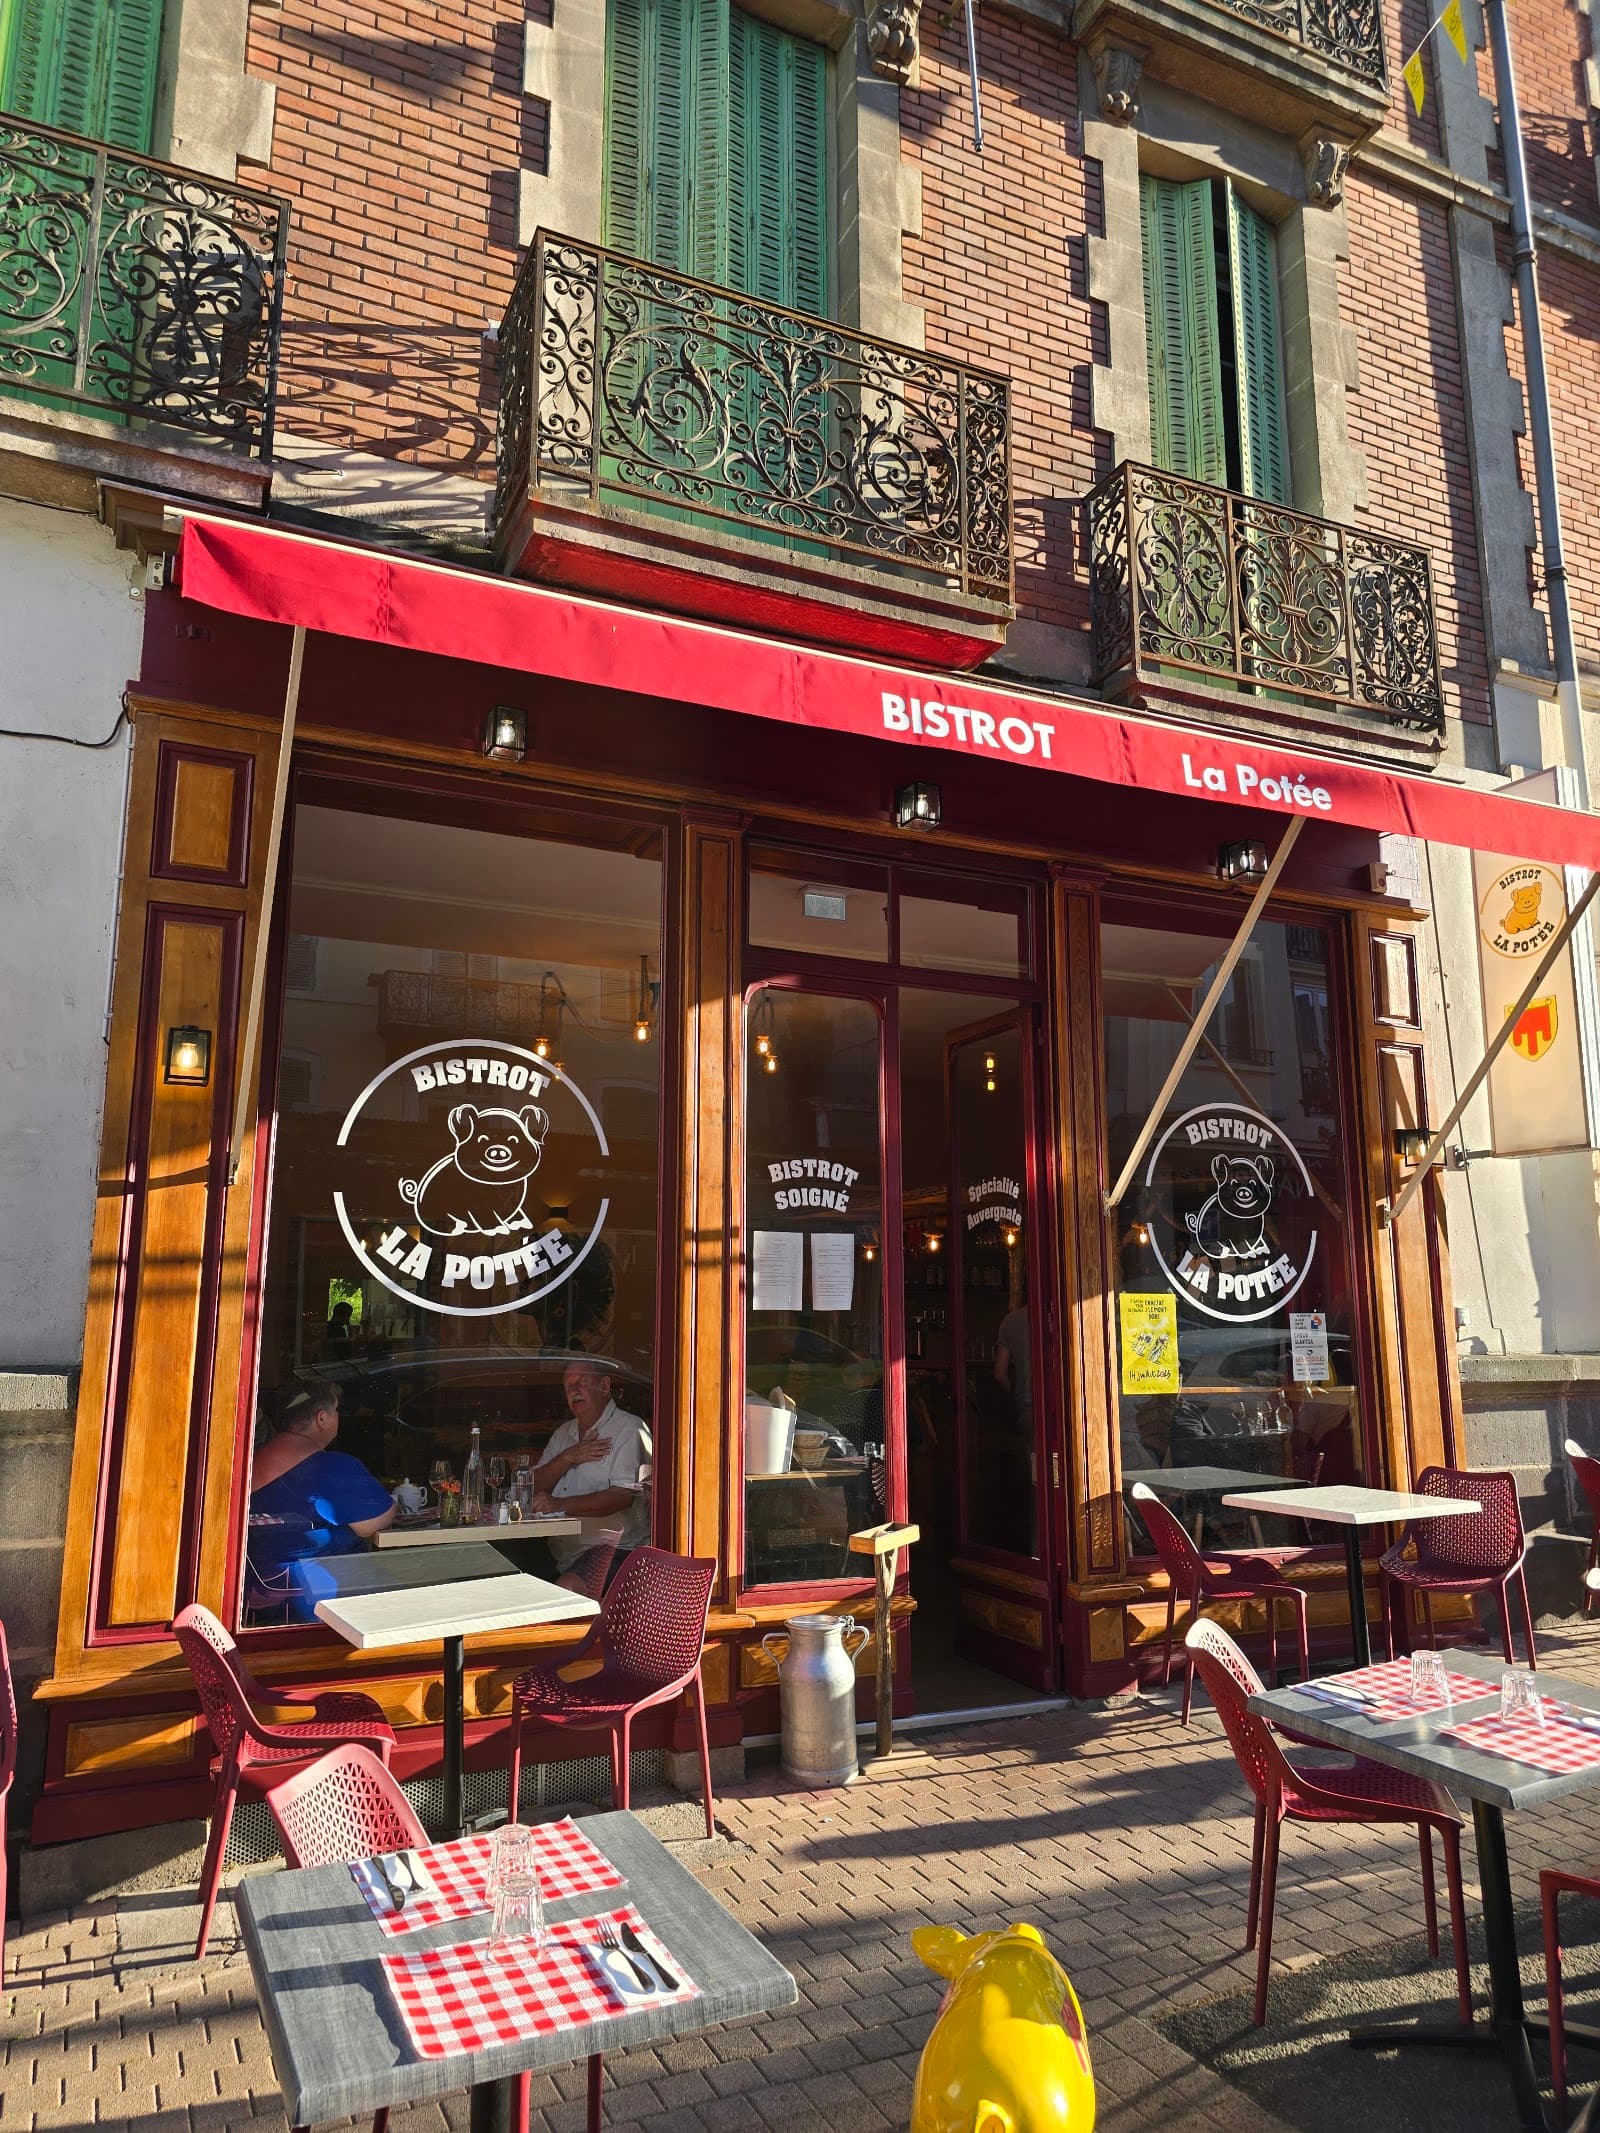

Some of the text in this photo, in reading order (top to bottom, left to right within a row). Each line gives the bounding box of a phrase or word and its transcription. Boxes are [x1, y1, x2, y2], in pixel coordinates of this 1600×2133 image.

[881, 692, 1056, 759] BISTROT
[1182, 754, 1332, 811] La Potée
[1499, 869, 1542, 890] BISTROT
[1493, 921, 1555, 953] LA POTÉE
[411, 1058, 550, 1097] BISTROT
[1185, 1118, 1272, 1150] BISTROT
[768, 1158, 859, 1187] BISTROT
[774, 1187, 850, 1213] SOIGNÉ
[968, 1176, 1021, 1203] Spécialité
[967, 1205, 1022, 1231] Auvergnate
[376, 1226, 574, 1289] LA POTÉE
[1175, 1250, 1298, 1302] LA POTÉE
